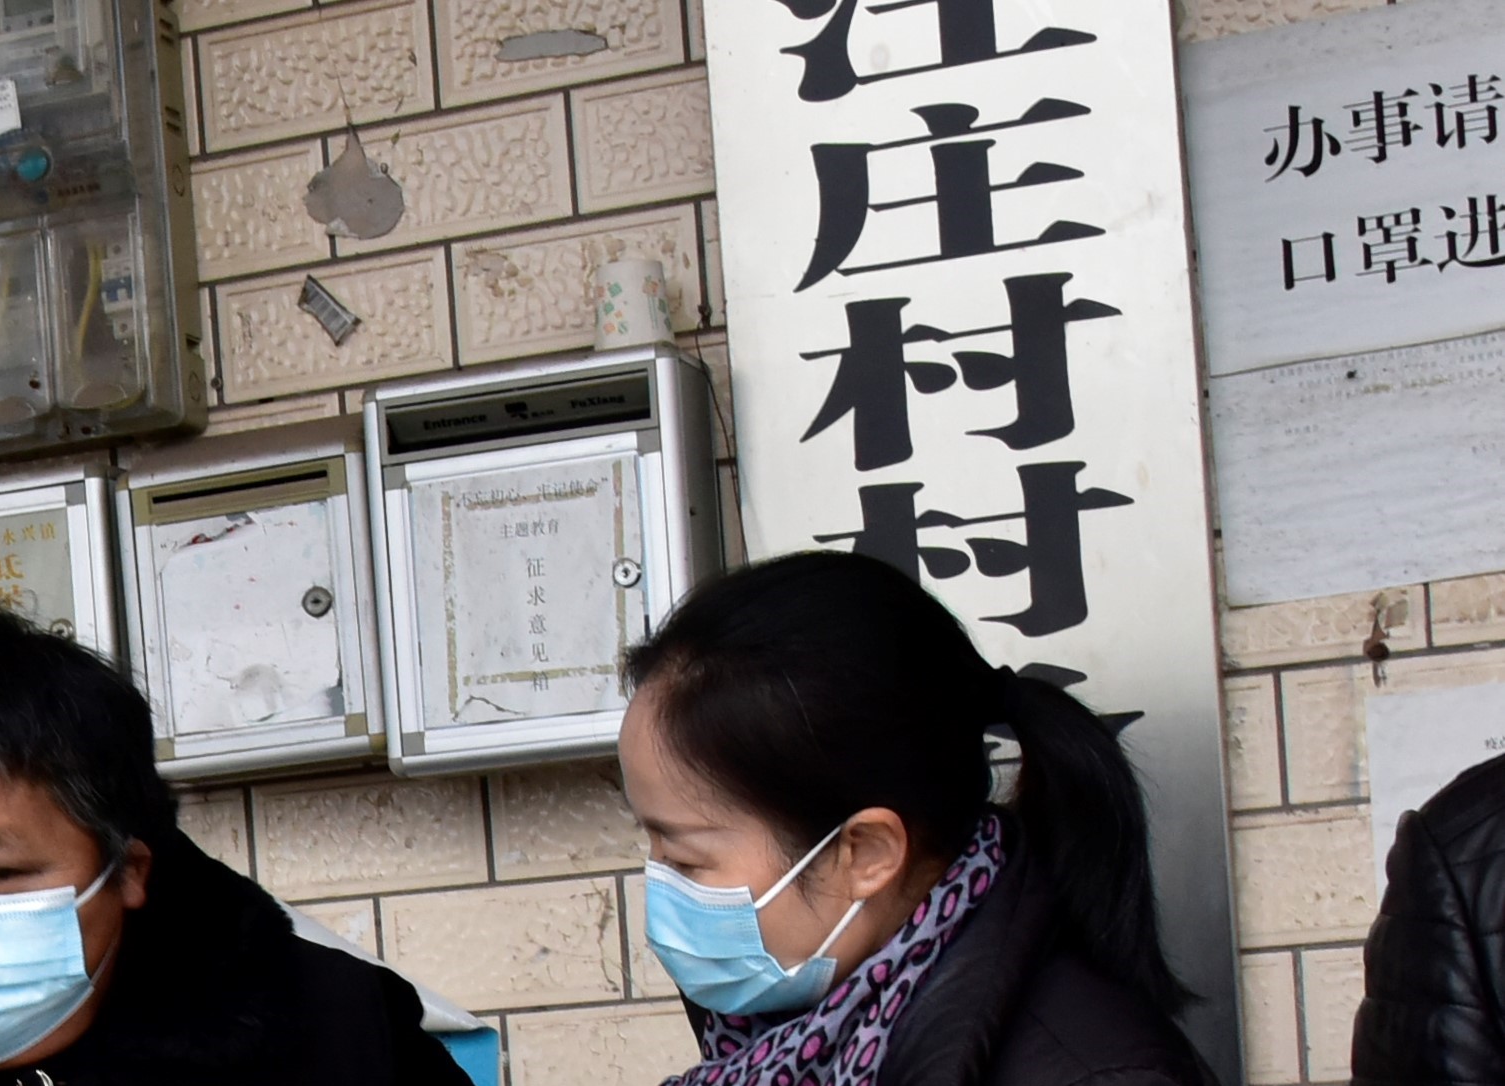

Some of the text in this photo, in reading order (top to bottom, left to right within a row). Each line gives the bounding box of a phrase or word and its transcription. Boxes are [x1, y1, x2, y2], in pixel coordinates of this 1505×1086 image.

[1263, 74, 1504, 183] 办事请
[1281, 194, 1505, 291] 口罩进
[423, 413, 488, 431] Entrance
[500, 518, 559, 539] 主题教育
[526, 557, 549, 692] 征求意见箱
